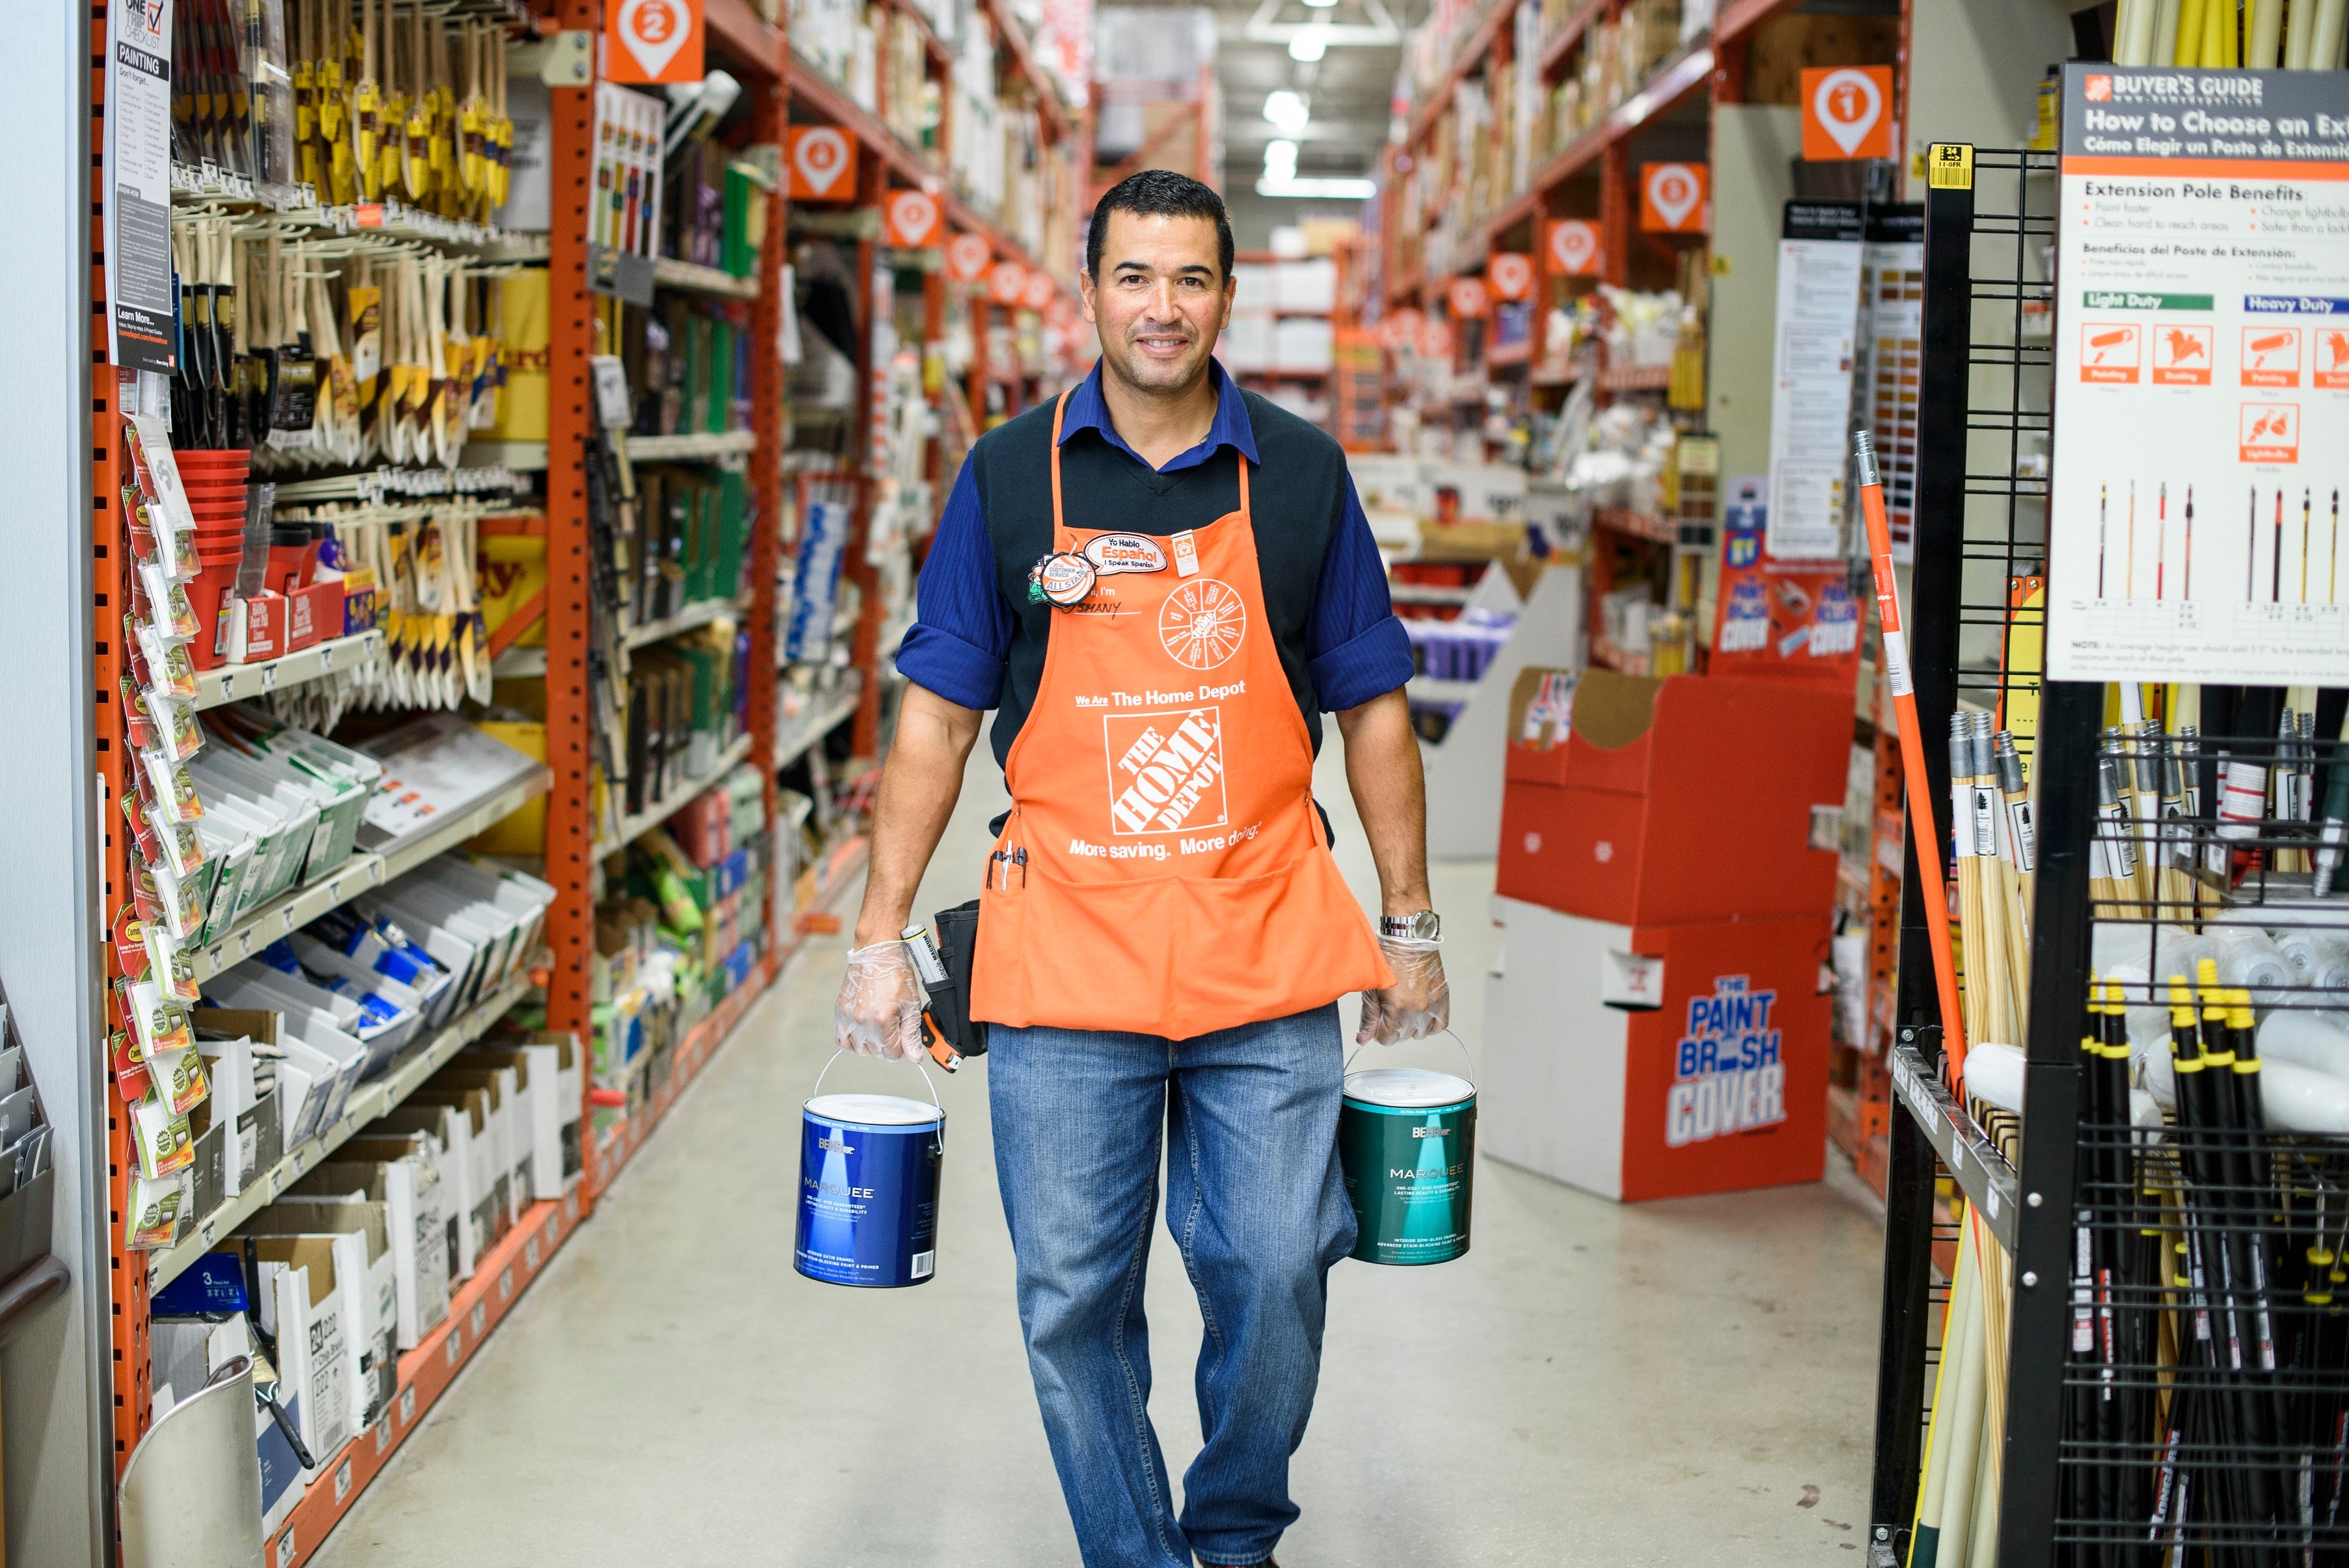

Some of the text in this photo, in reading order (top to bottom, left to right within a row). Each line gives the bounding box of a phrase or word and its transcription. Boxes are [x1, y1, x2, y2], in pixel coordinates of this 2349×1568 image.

[126, 8, 145, 29] TRIP
[643, 12, 665, 38] 2
[125, 24, 160, 49] CHECKLIST
[119, 44, 159, 75] PAINTING
[119, 67, 150, 86] Don't forget...
[2113, 74, 2263, 97] BUYER'S GUIDE
[1837, 94, 1854, 120] 1
[2085, 109, 2145, 133] How
[2150, 111, 2176, 133] to
[2181, 109, 2271, 135] Choose
[2277, 117, 2310, 138] an
[2084, 136, 2281, 158] Cómo Elegir un Poste de
[2085, 181, 2222, 198] Extension Pole
[2095, 202, 2151, 213] Paint faster
[2262, 206, 2301, 219] Change
[2095, 217, 2229, 231] Clean hard to reach areas
[2262, 221, 2287, 232] Safer
[2292, 222, 2313, 232] than
[2084, 243, 2296, 258] Beneficios del Poste de Extensión:
[2088, 292, 2162, 310] Light Duty
[2249, 297, 2334, 314] Heavy Duty
[118, 308, 154, 325] Learn More...
[118, 329, 168, 345] homedepot.com/knowhow
[2091, 370, 2128, 381] Painting
[2165, 372, 2197, 382] Dusting
[2251, 373, 2287, 385] Painting
[2247, 449, 2289, 460] Lightbulbs
[1119, 539, 1140, 548] Hablo
[1102, 546, 1158, 563] Español
[1046, 571, 1085, 590] ALL STAR
[1100, 587, 1115, 596] I'm
[1075, 680, 1246, 707] We Are The Home Depot
[1117, 725, 1166, 776] THE
[1113, 710, 1220, 833] HOME
[1156, 751, 1222, 831] DEPOT
[1069, 839, 1107, 858] More
[1109, 842, 1171, 861] saving.
[1180, 835, 1225, 856] More
[923, 934, 938, 961] MAGNUM
[1718, 978, 1746, 992] THE
[1690, 994, 1775, 1036] PAINT
[179, 1036, 188, 1045] 3M
[197, 1085, 204, 1096] 3M
[1667, 1062, 1786, 1145] COVER
[1412, 1126, 1441, 1138] BEHR
[819, 1137, 843, 1153] BEHR
[183, 1151, 193, 1162] 3M
[1390, 1163, 1463, 1179] MARQUEE
[804, 1176, 875, 1198] MARQUEE
[1439, 1185, 1460, 1194] DURABILITY
[806, 1199, 819, 1208] LASTING
[807, 1195, 822, 1203] ONE-COAT
[159, 1232, 170, 1240] 3M
[807, 1249, 822, 1258] INTERIOR
[808, 1255, 840, 1266] STAIN-BLOCKING
[203, 1271, 212, 1286] 3
[310, 1313, 336, 1353] 24 222
[318, 1337, 344, 1365] Chip Brush
[315, 1371, 329, 1397] 222
